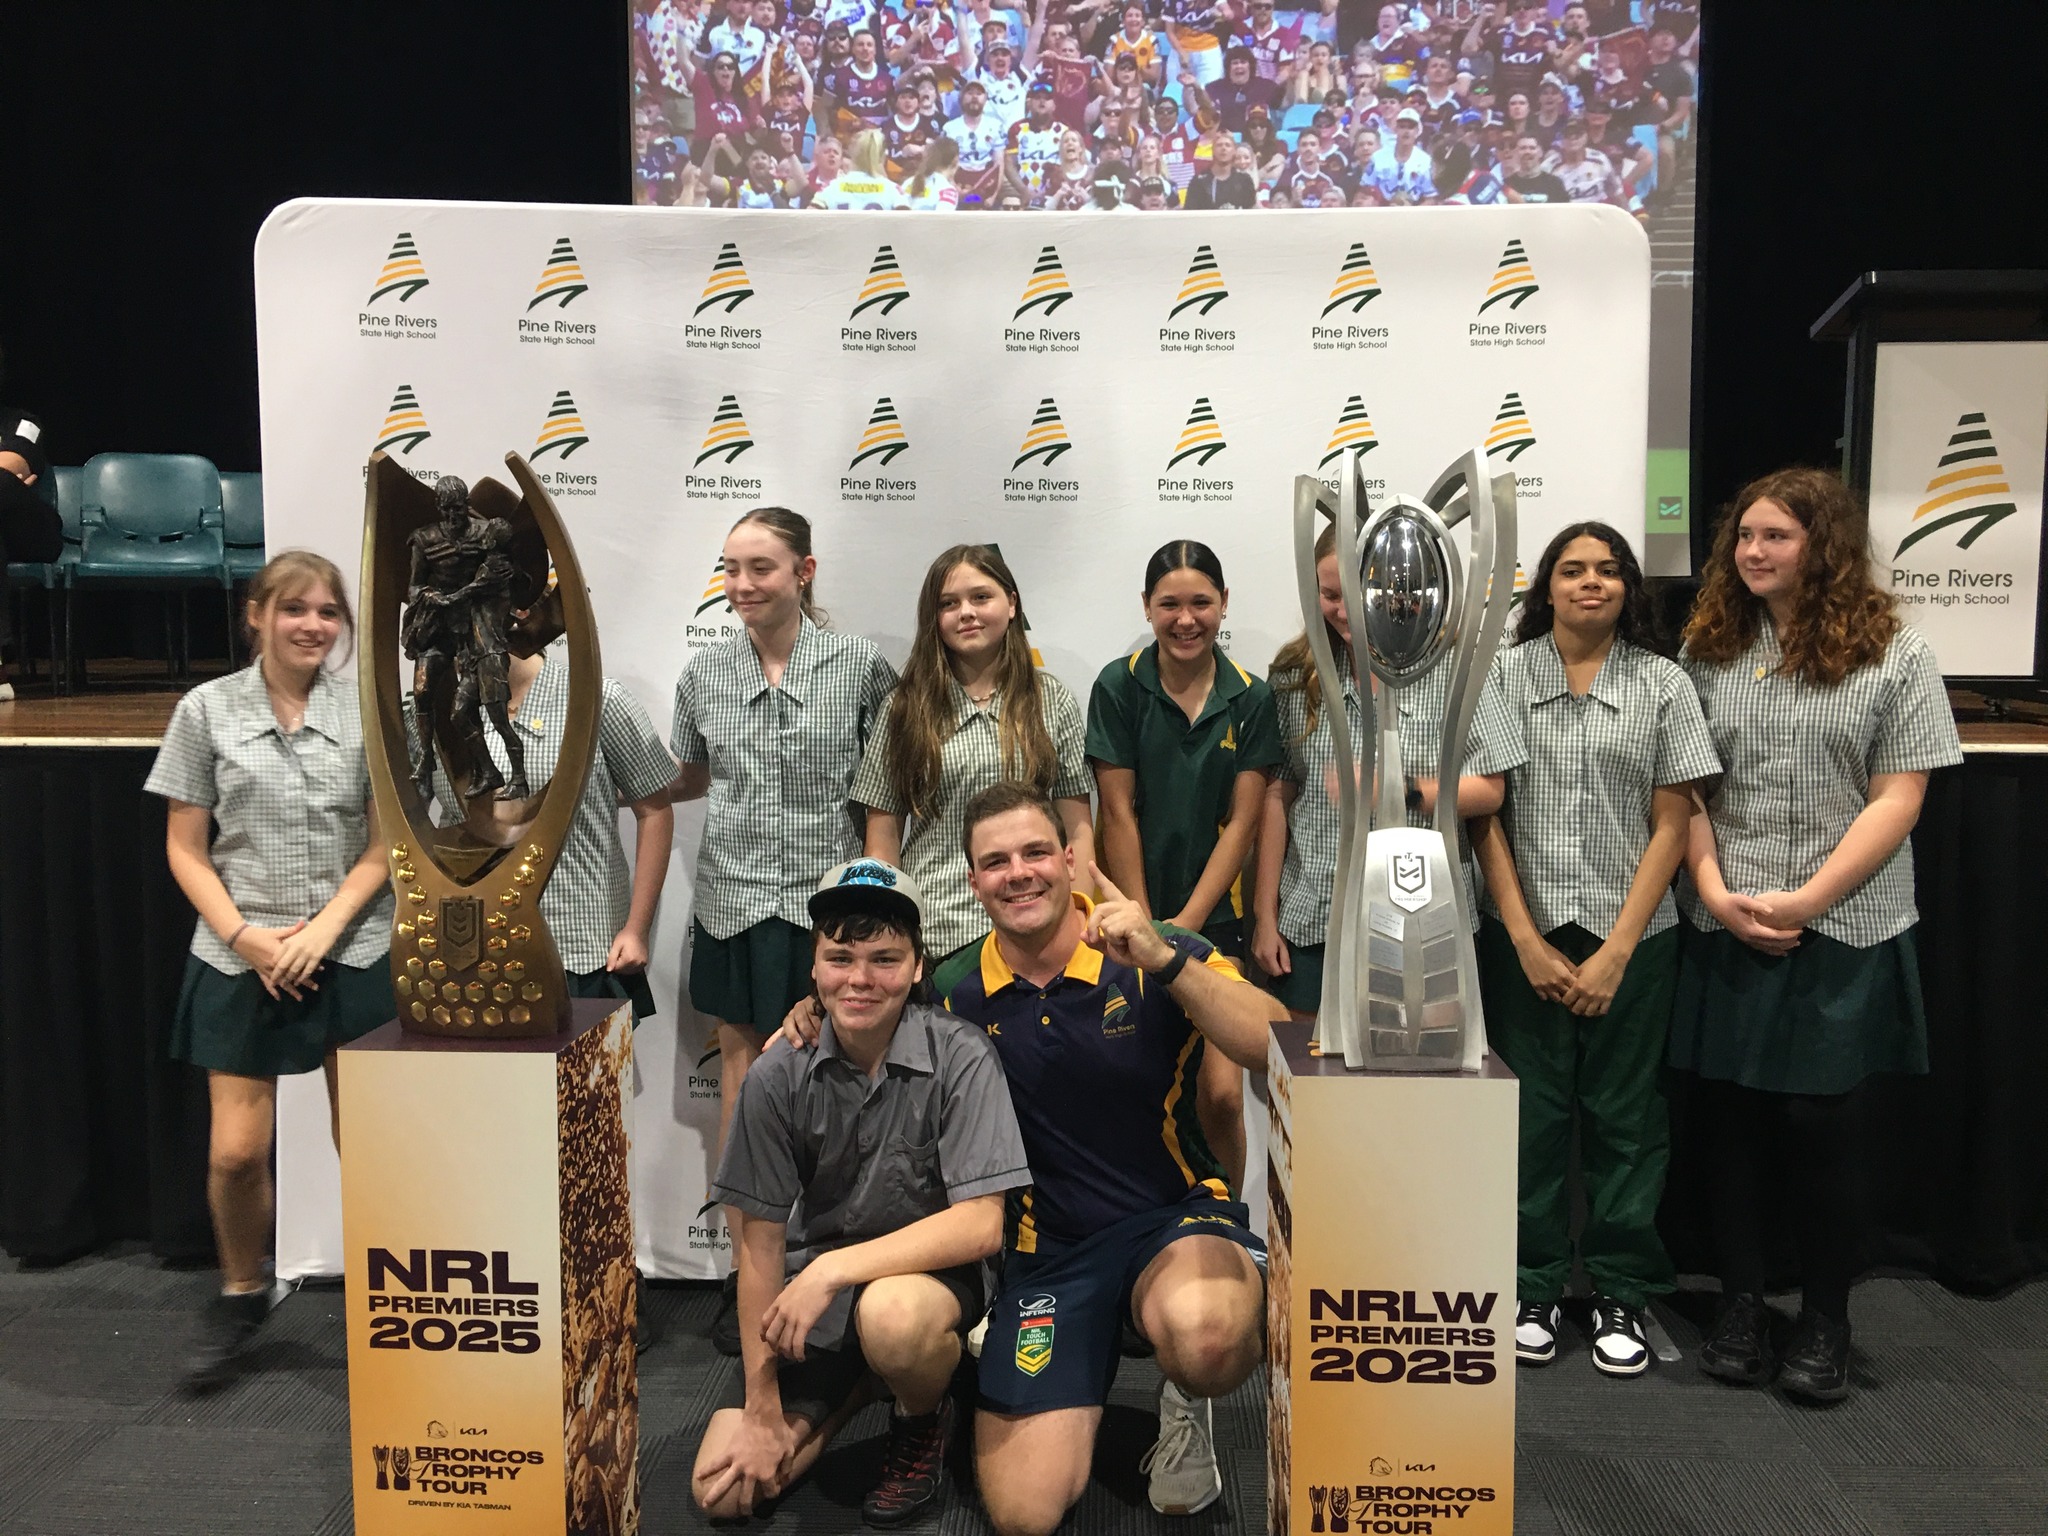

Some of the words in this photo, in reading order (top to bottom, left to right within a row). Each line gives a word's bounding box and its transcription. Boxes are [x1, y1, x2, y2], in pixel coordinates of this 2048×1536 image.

[359, 313, 390, 326] Pine
[396, 315, 437, 328] Rivers
[519, 320, 550, 332] Pine
[555, 321, 596, 334] Rivers
[686, 325, 716, 337] Pine
[721, 326, 762, 338] Rivers
[1312, 327, 1342, 339] Pine
[1348, 326, 1388, 338] Rivers
[1470, 324, 1500, 335] Pine
[1505, 323, 1546, 335] Rivers
[361, 329, 382, 337] State
[385, 330, 404, 339] High
[407, 331, 436, 339] School
[520, 335, 541, 343] State
[544, 336, 563, 345] High
[842, 328, 872, 340] Pine
[876, 328, 917, 340] Rivers
[1005, 329, 1035, 341] Pine
[1040, 329, 1080, 341] Rivers
[1160, 328, 1190, 340] Pine
[1195, 328, 1235, 340] Rivers
[686, 340, 707, 348] State
[710, 341, 729, 350] High
[866, 344, 885, 353] High
[1006, 344, 1026, 352] State
[1029, 344, 1048, 353] High
[1051, 344, 1079, 352] School
[1184, 344, 1203, 353] High
[1337, 342, 1356, 351] High
[1494, 339, 1513, 347] High
[403, 467, 440, 480] ivers
[556, 472, 597, 485] Rivers
[686, 475, 716, 488] Pine
[721, 476, 761, 488] Rivers
[841, 478, 871, 490] Pine
[876, 478, 916, 490] Rivers
[1004, 478, 1034, 490] Pine
[1039, 478, 1079, 490] Rivers
[1158, 479, 1188, 490] Pine
[1193, 478, 1233, 490] Rivers
[567, 488, 596, 496] School
[687, 490, 708, 498] State
[710, 491, 729, 500] High
[842, 493, 863, 501] State
[865, 494, 884, 502] High
[1516, 490, 1542, 498] chool
[1028, 494, 1047, 503] High
[1182, 494, 1201, 503] High
[1892, 569, 1940, 587] Pine
[1948, 569, 2013, 587] Rivers
[1930, 594, 1960, 607] High
[1964, 593, 2010, 604] School
[686, 625, 717, 637] Pine
[687, 640, 708, 648] State
[689, 1076, 719, 1088] Pine
[690, 1091, 711, 1099] State
[688, 1226, 718, 1238] Pine
[689, 1241, 710, 1249] State
[712, 1242, 731, 1251] High
[367, 1248, 539, 1295] NRL
[368, 1295, 539, 1317] PREMIERS
[1310, 1289, 1498, 1323] NRLW
[369, 1317, 541, 1354] 2025
[1020, 1337, 1050, 1346] FOOTBALL
[1311, 1325, 1496, 1346] PREMIERS
[1310, 1347, 1497, 1385] 2025
[415, 1446, 544, 1465] BRONCOS
[410, 1459, 521, 1480] TROPHY
[1405, 1464, 1436, 1472] KIA
[417, 1479, 487, 1495] TOUR
[1356, 1486, 1496, 1501] BRONCOS
[408, 1500, 441, 1508] DRIVEN
[1350, 1499, 1470, 1520] TROPHY
[1356, 1520, 1432, 1535] TOUR
